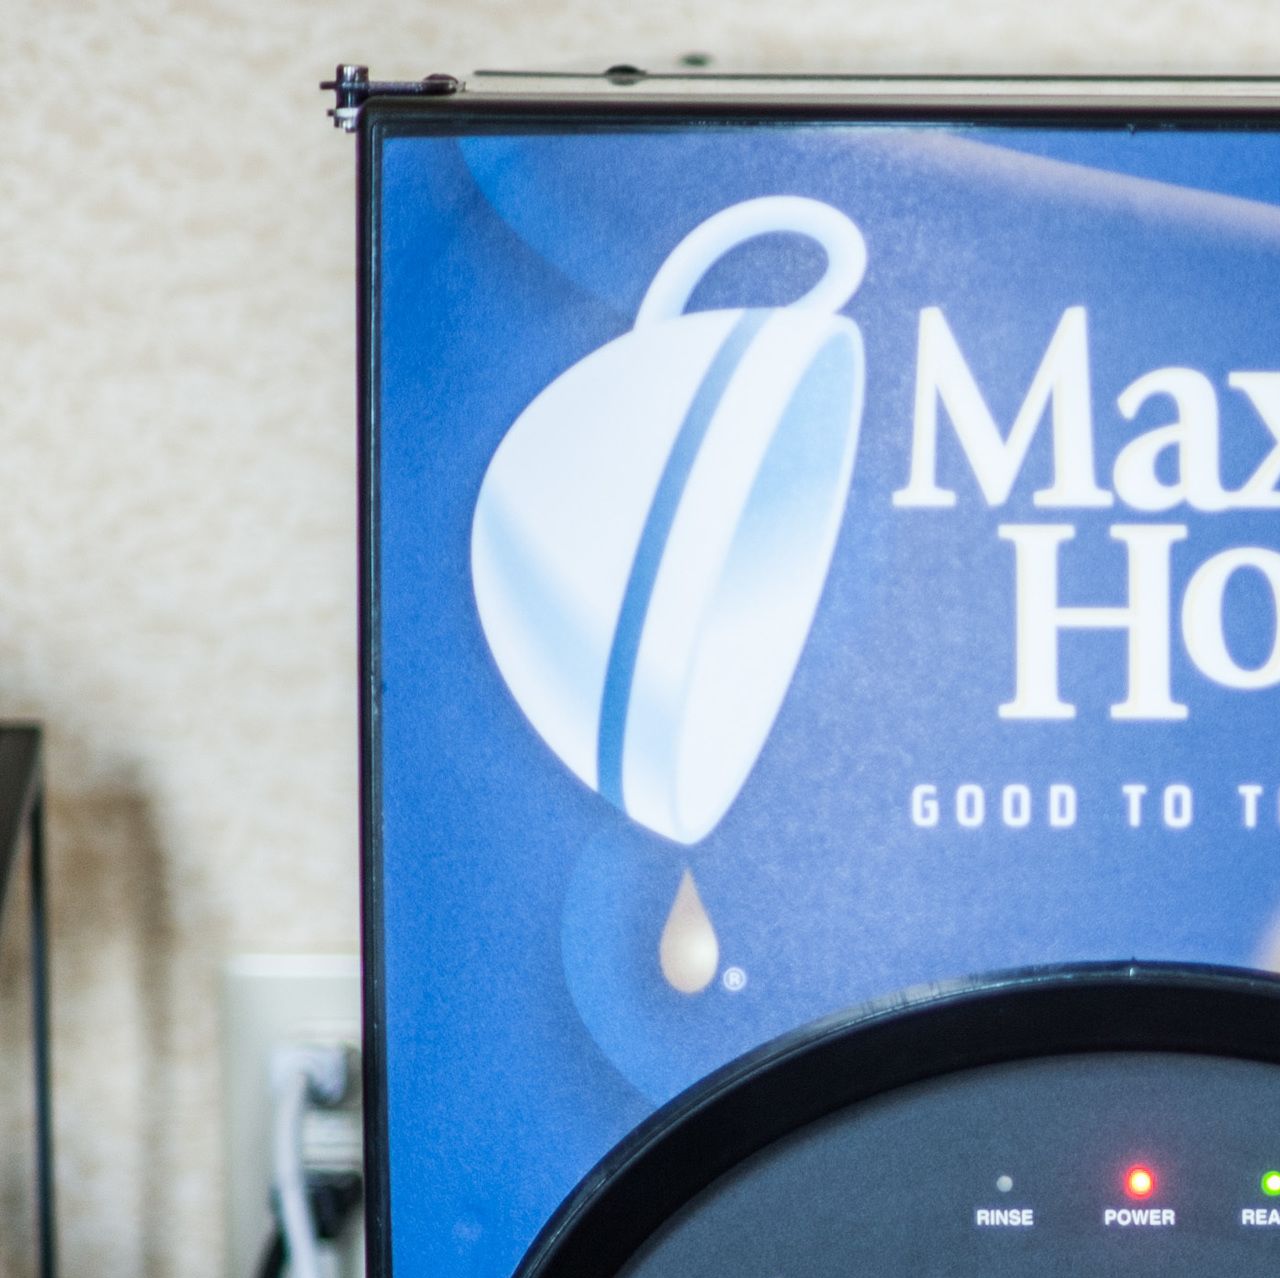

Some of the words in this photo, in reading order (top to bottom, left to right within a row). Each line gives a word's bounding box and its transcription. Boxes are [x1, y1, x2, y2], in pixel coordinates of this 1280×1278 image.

[911, 784, 1077, 829] GOOD
[1123, 784, 1193, 829] TO
[976, 1208, 1034, 1226] RINSE
[1104, 1208, 1176, 1226] POWER
